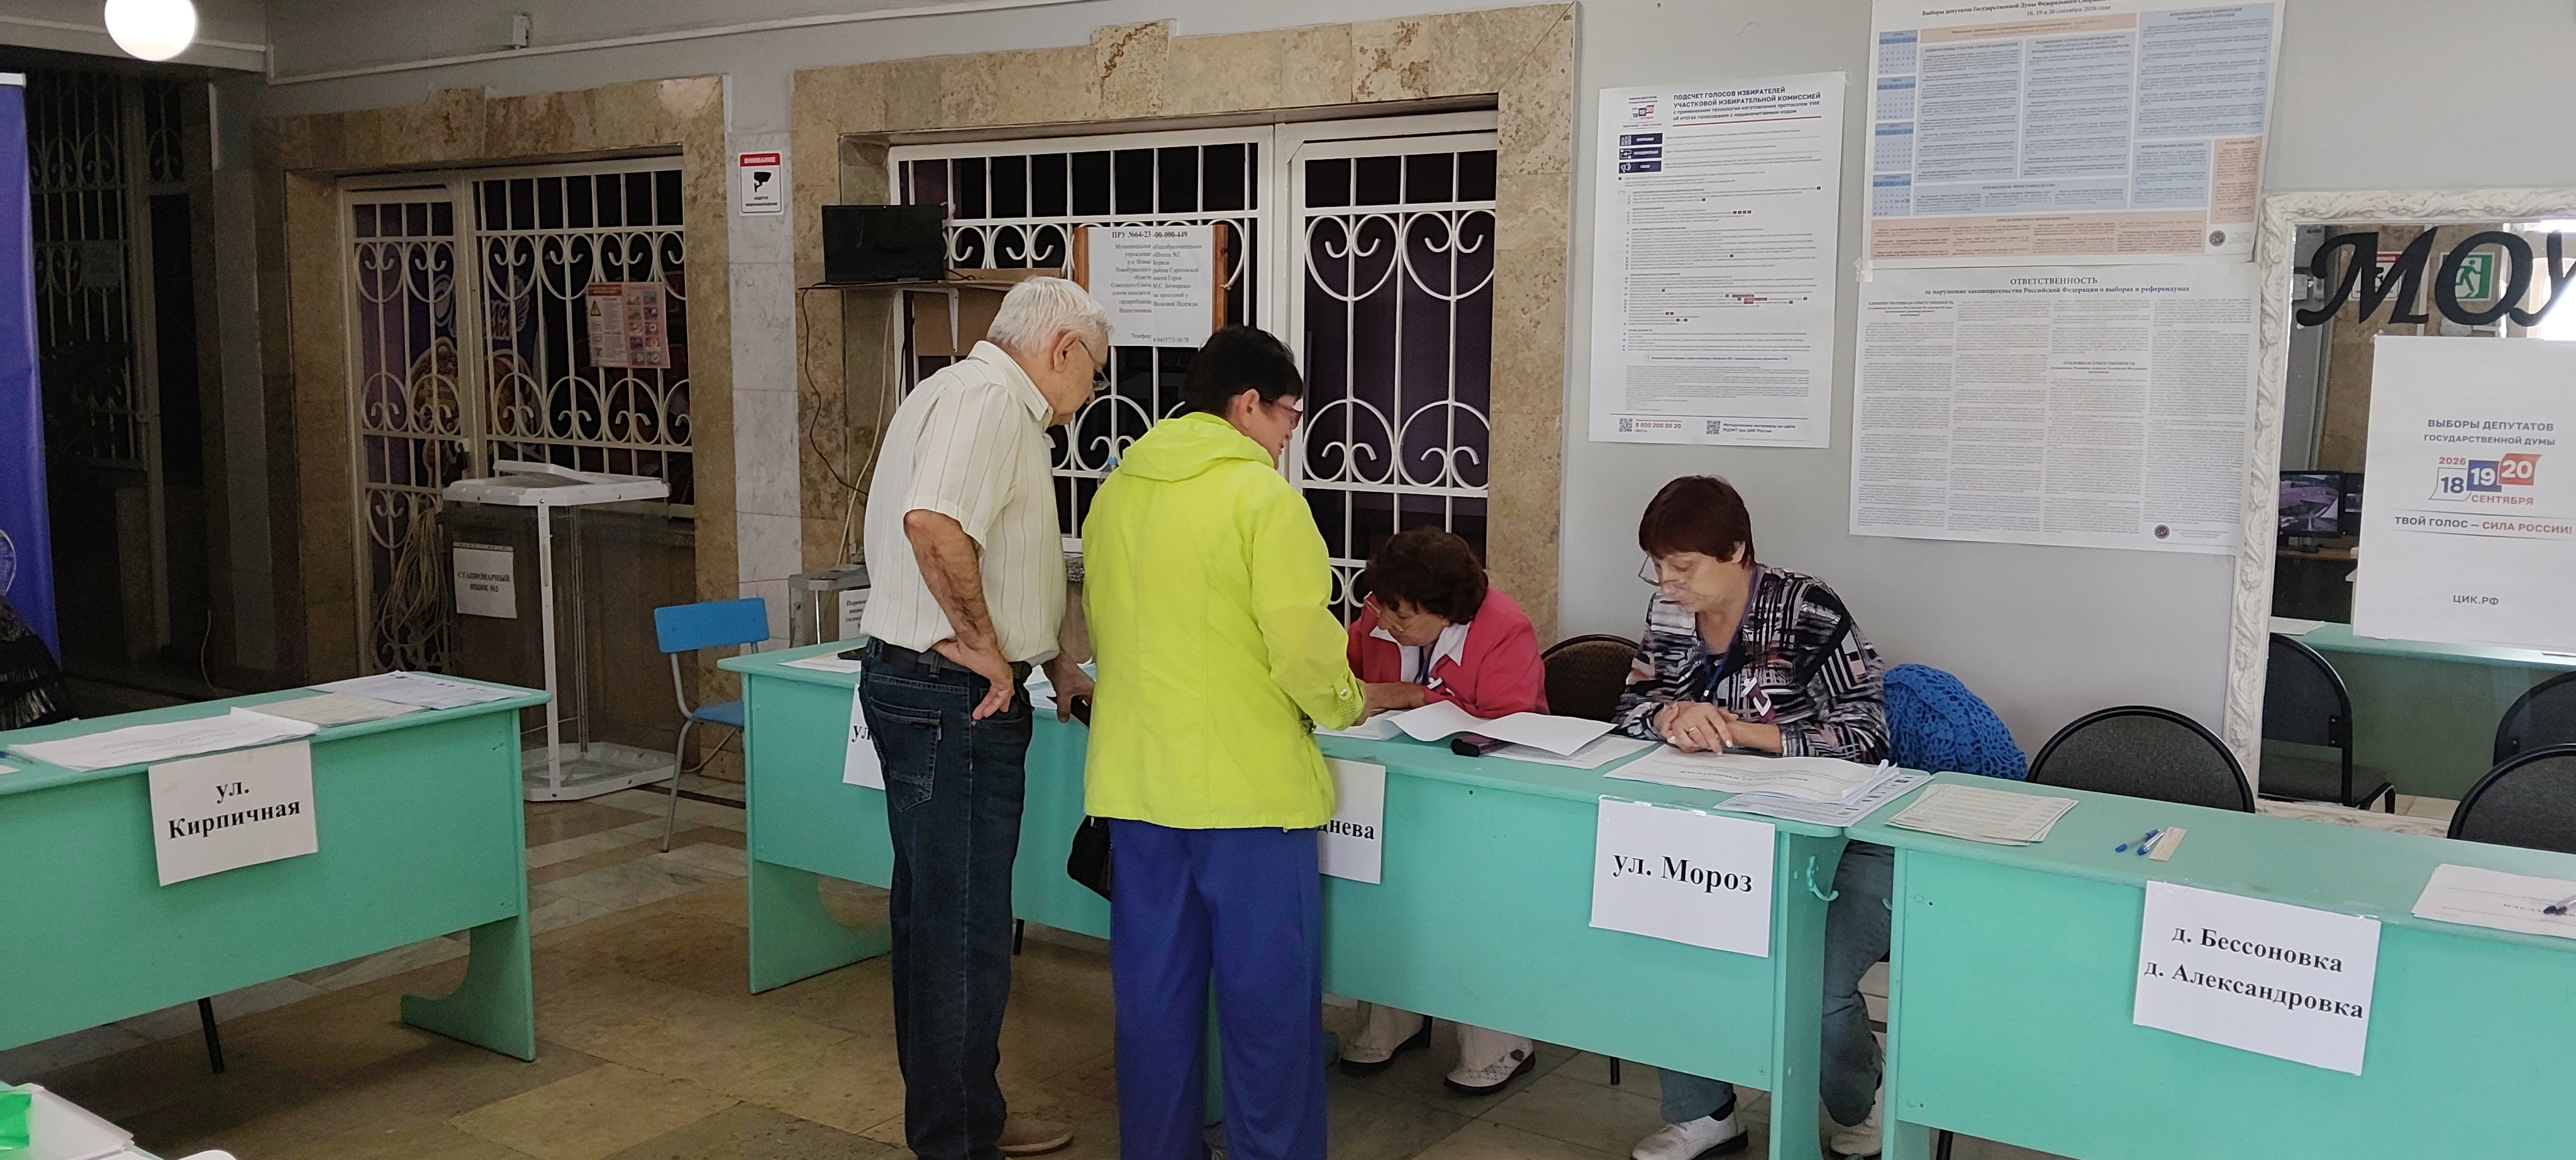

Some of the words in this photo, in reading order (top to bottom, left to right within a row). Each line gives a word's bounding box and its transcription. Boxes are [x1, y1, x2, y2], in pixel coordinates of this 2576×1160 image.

[1974, 3, 2019, 12] Государственной
[1737, 86, 1785, 96] ИЗБИРАТЕЛЕЙ
[1674, 99, 1717, 108] УЧАСТКОВОЙ
[1719, 95, 1776, 105] ИЗБИРАТЕЛЬНОЙ
[1778, 92, 1821, 101] КОМИССИЕЙ
[2141, 286, 2189, 294] референдумах
[2428, 419, 2479, 429] ВЫБОРЫ
[2482, 421, 2554, 432] ДЕПУТАТОВ
[2424, 434, 2522, 445] ГОСУДАРСТВЕННОЙ
[2524, 438, 2556, 446] ДУМЫ
[2438, 457, 2466, 466] 2026
[2441, 477, 2464, 494] 18
[2470, 467, 2495, 486] 19
[2501, 460, 2533, 479] 20
[2471, 494, 2534, 506] СЕНТЯБРЯ
[2395, 516, 2426, 526] ТВОЙ
[2429, 518, 2468, 528] ГОЛОС
[2482, 521, 2515, 531] СИЛА
[2518, 523, 2573, 535] РОССИИ!
[2453, 594, 2499, 605] ЦИК.РФ
[216, 781, 250, 804] ул.
[168, 801, 301, 840] Кирпичная
[1613, 854, 1652, 877] ул.
[1660, 856, 1752, 894] Мороз
[2172, 927, 2192, 944] д.
[2200, 928, 2343, 973] Бессоновка
[2143, 962, 2163, 978] д.
[2171, 964, 2363, 1018] Александровка
